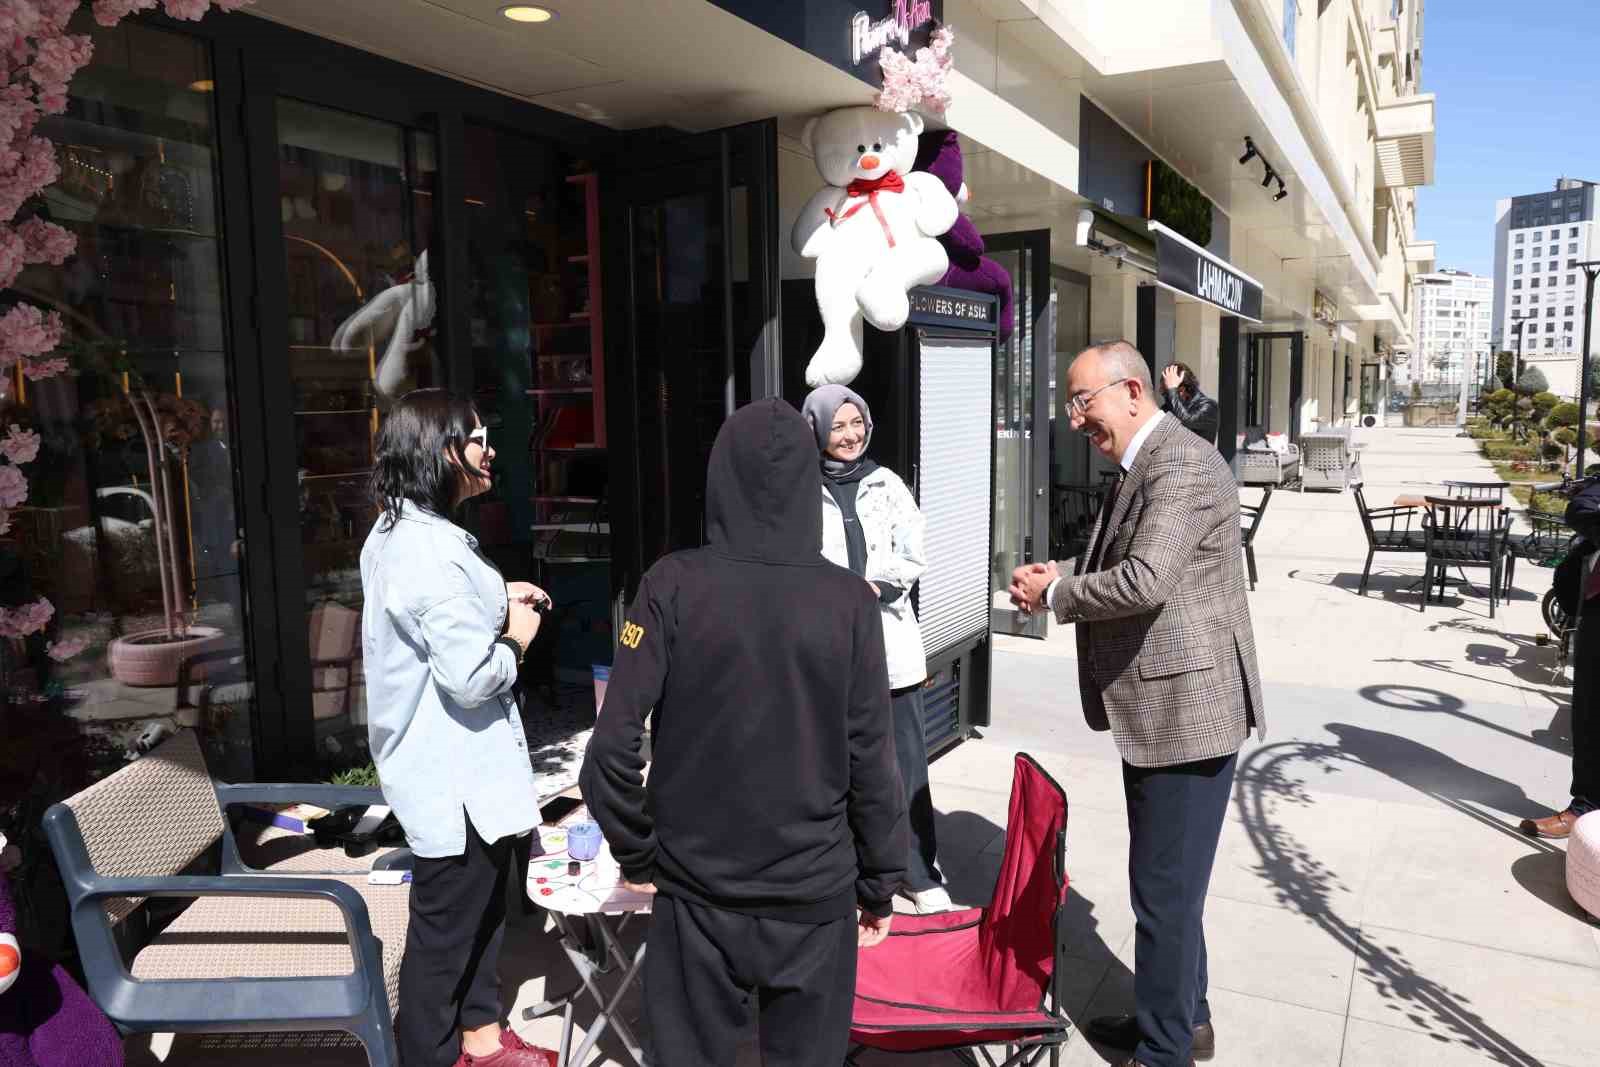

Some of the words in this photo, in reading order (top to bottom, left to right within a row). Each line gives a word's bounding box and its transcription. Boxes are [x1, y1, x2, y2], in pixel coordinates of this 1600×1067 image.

[1197, 256, 1243, 313] LAHMACUN
[910, 295, 953, 316] FLOWERS
[955, 302, 967, 317] OF
[968, 303, 987, 320] ASIA
